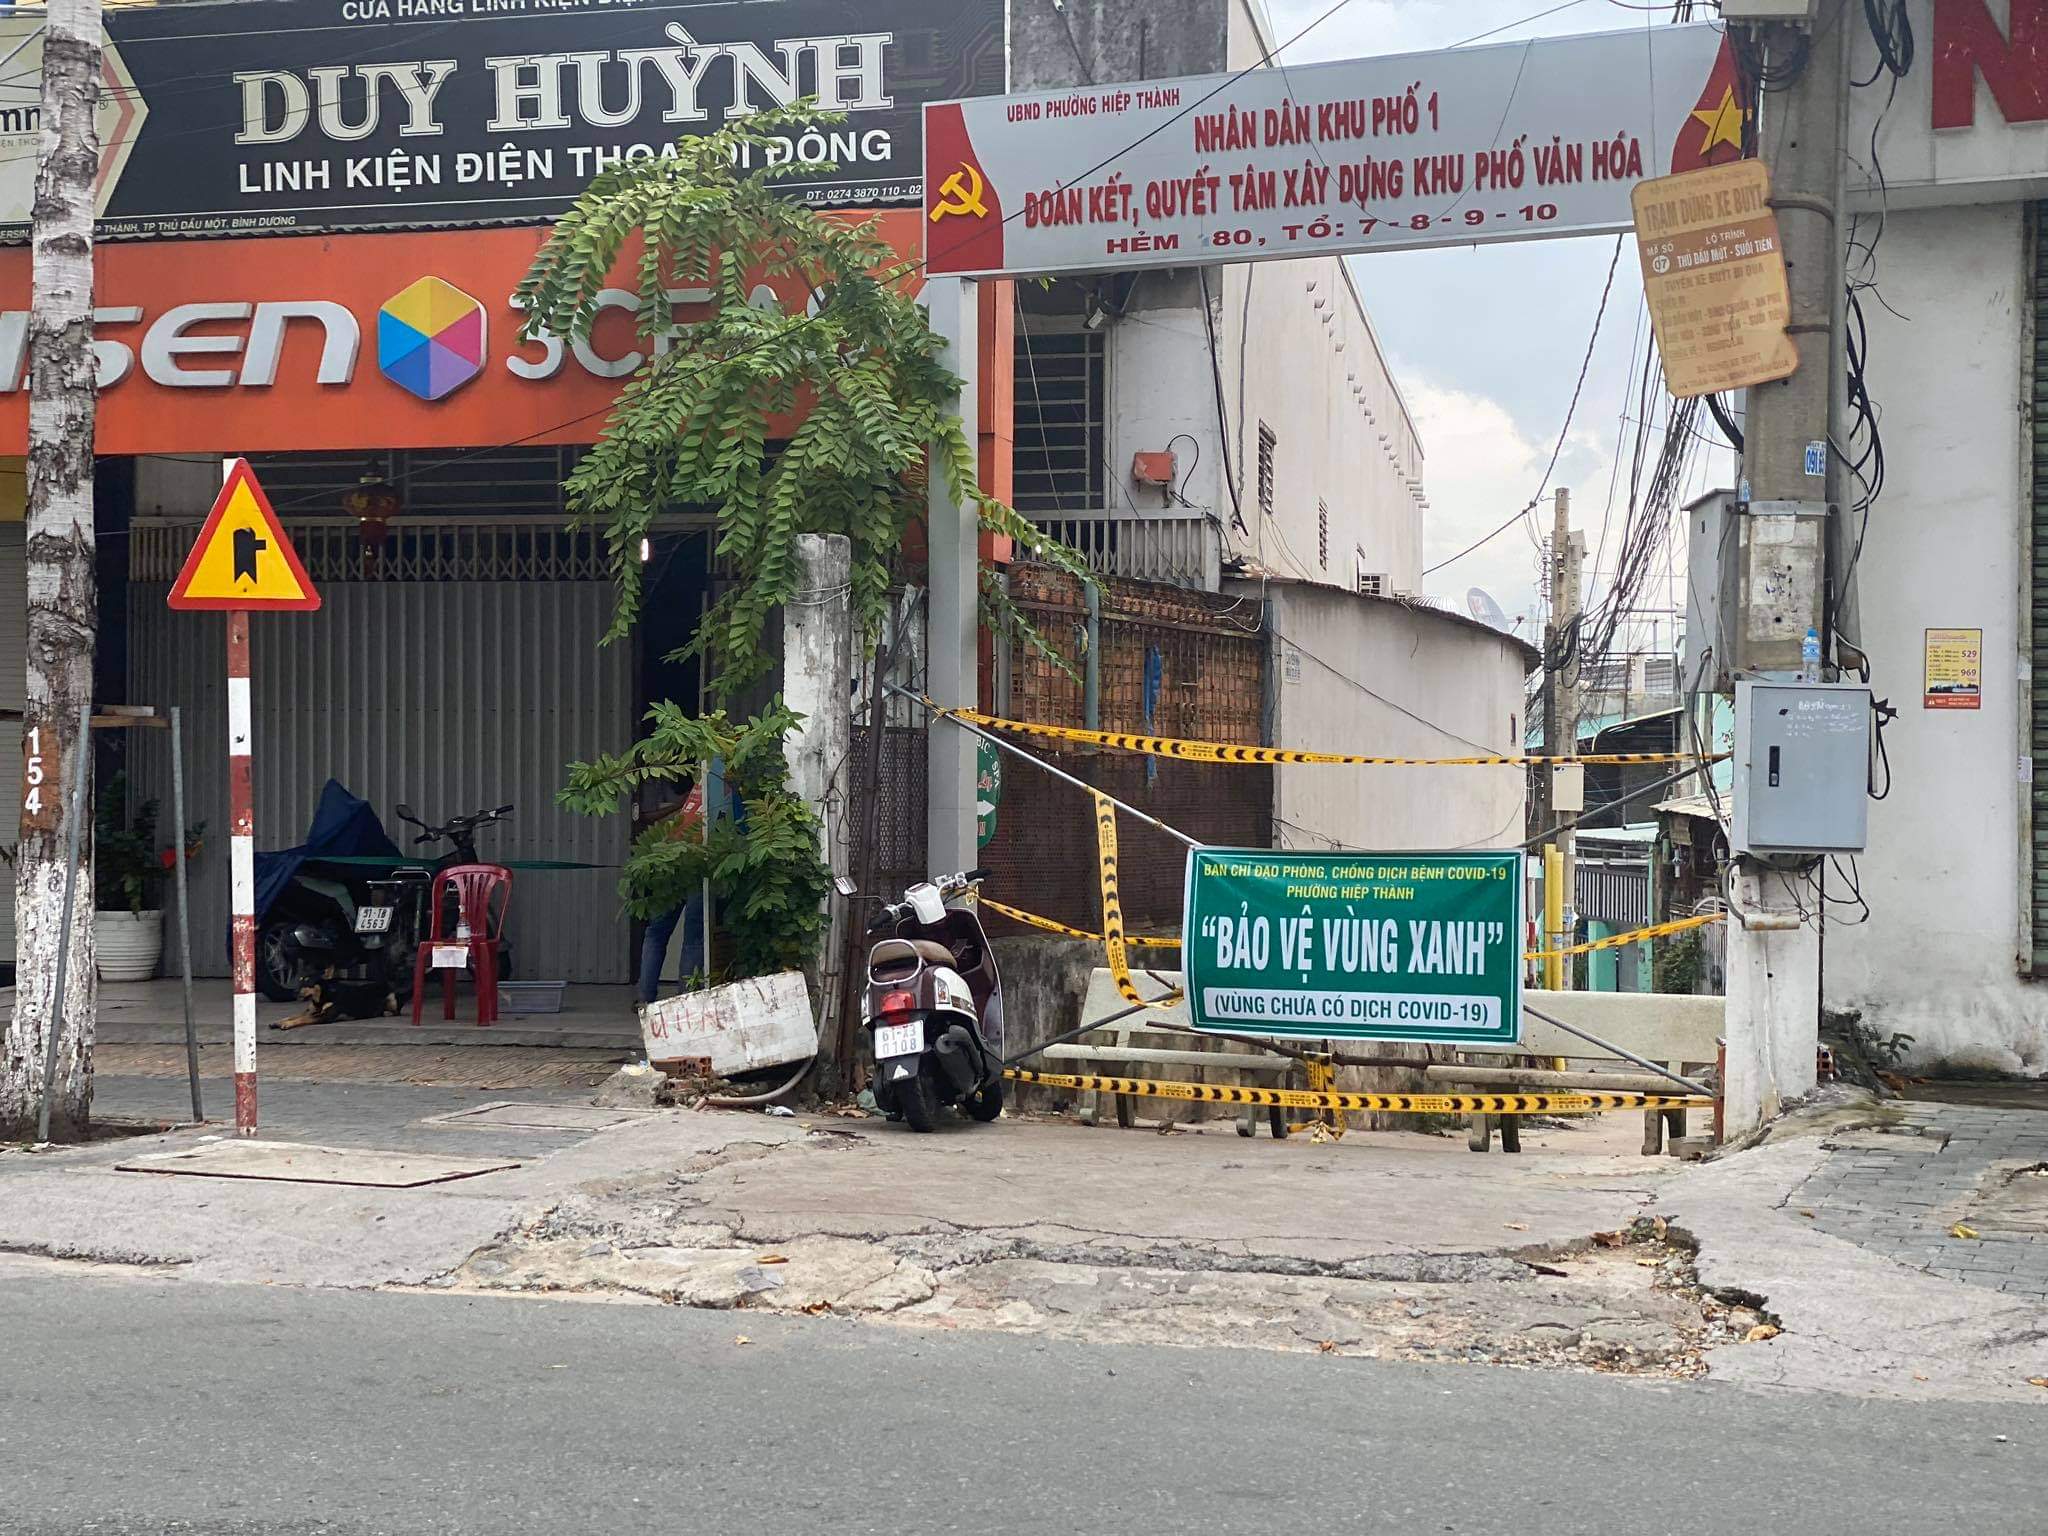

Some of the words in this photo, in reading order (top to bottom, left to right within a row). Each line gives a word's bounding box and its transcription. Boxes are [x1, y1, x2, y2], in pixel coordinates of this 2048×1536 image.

[233, 60, 457, 144] DUY
[485, 22, 893, 132] HUỲNH
[1007, 102, 1041, 122] UBND
[1046, 92, 1097, 118] PHƯỜNG
[1102, 90, 1132, 116] HIỆP
[1136, 86, 1181, 109] THÀNH
[1194, 104, 1257, 153] NHÂN
[1264, 98, 1311, 147] DÂN
[1318, 99, 1365, 142] KHU
[1372, 81, 1421, 137] PHỐ
[1428, 91, 1439, 131] 1
[240, 159, 330, 193] LINH
[346, 148, 440, 192] KIỆN
[456, 142, 553, 188] ĐIỆN
[567, 142, 684, 180] THOẠ
[1025, 180, 1083, 228] ĐOÀN
[1089, 171, 1139, 228] KẾT,
[1146, 165, 1221, 219] QUYẾT
[1229, 164, 1276, 212] TÂM
[1283, 159, 1329, 208] XÂY
[1339, 155, 1403, 211] DỰNG
[1413, 153, 1464, 197] KHU
[1475, 134, 1527, 191] PHỐ
[1533, 135, 1583, 186] VĂN
[1592, 130, 1644, 181] HÓA
[806, 190, 825, 200] ĐT:
[827, 189, 851, 199] 0274
[854, 187, 879, 198] 3870
[882, 186, 900, 196] 110
[908, 184, 922, 194] 02
[143, 222, 156, 231] TP
[232, 216, 256, 228] BÌNH
[1282, 214, 1345, 241] TỔ:
[1359, 217, 1378, 235] 7
[1410, 213, 1430, 231] 8
[1464, 209, 1485, 226] 9
[1518, 203, 1557, 222] 10
[1644, 199, 1679, 234] TRẠM
[1715, 190, 1732, 218] XE
[1961, 650, 1977, 658] 529
[25, 726, 43, 815] 154
[1204, 863, 1227, 877] BAN
[1231, 861, 1250, 877] CHỈ
[1254, 865, 1279, 880] ĐẠO
[1283, 863, 1327, 880] PHÒNG,
[1332, 862, 1375, 879] CHỐNG
[1378, 866, 1407, 882] DỊCH
[1411, 864, 1444, 882] BỆNH
[1448, 866, 1506, 880] COVID-19
[1286, 884, 1337, 899] PHƯỜNG
[1341, 884, 1369, 901] HIỆP
[1373, 884, 1414, 900] THÀNH
[1279, 904, 1314, 984] VỆ
[1323, 905, 1398, 974] VÙNG
[1215, 991, 1265, 1016] (VÙNG
[1270, 994, 1317, 1017] CHƯA
[1321, 994, 1345, 1018] CÓ
[1350, 999, 1392, 1022] DỊCH
[1398, 1000, 1489, 1026] COVID-19)
